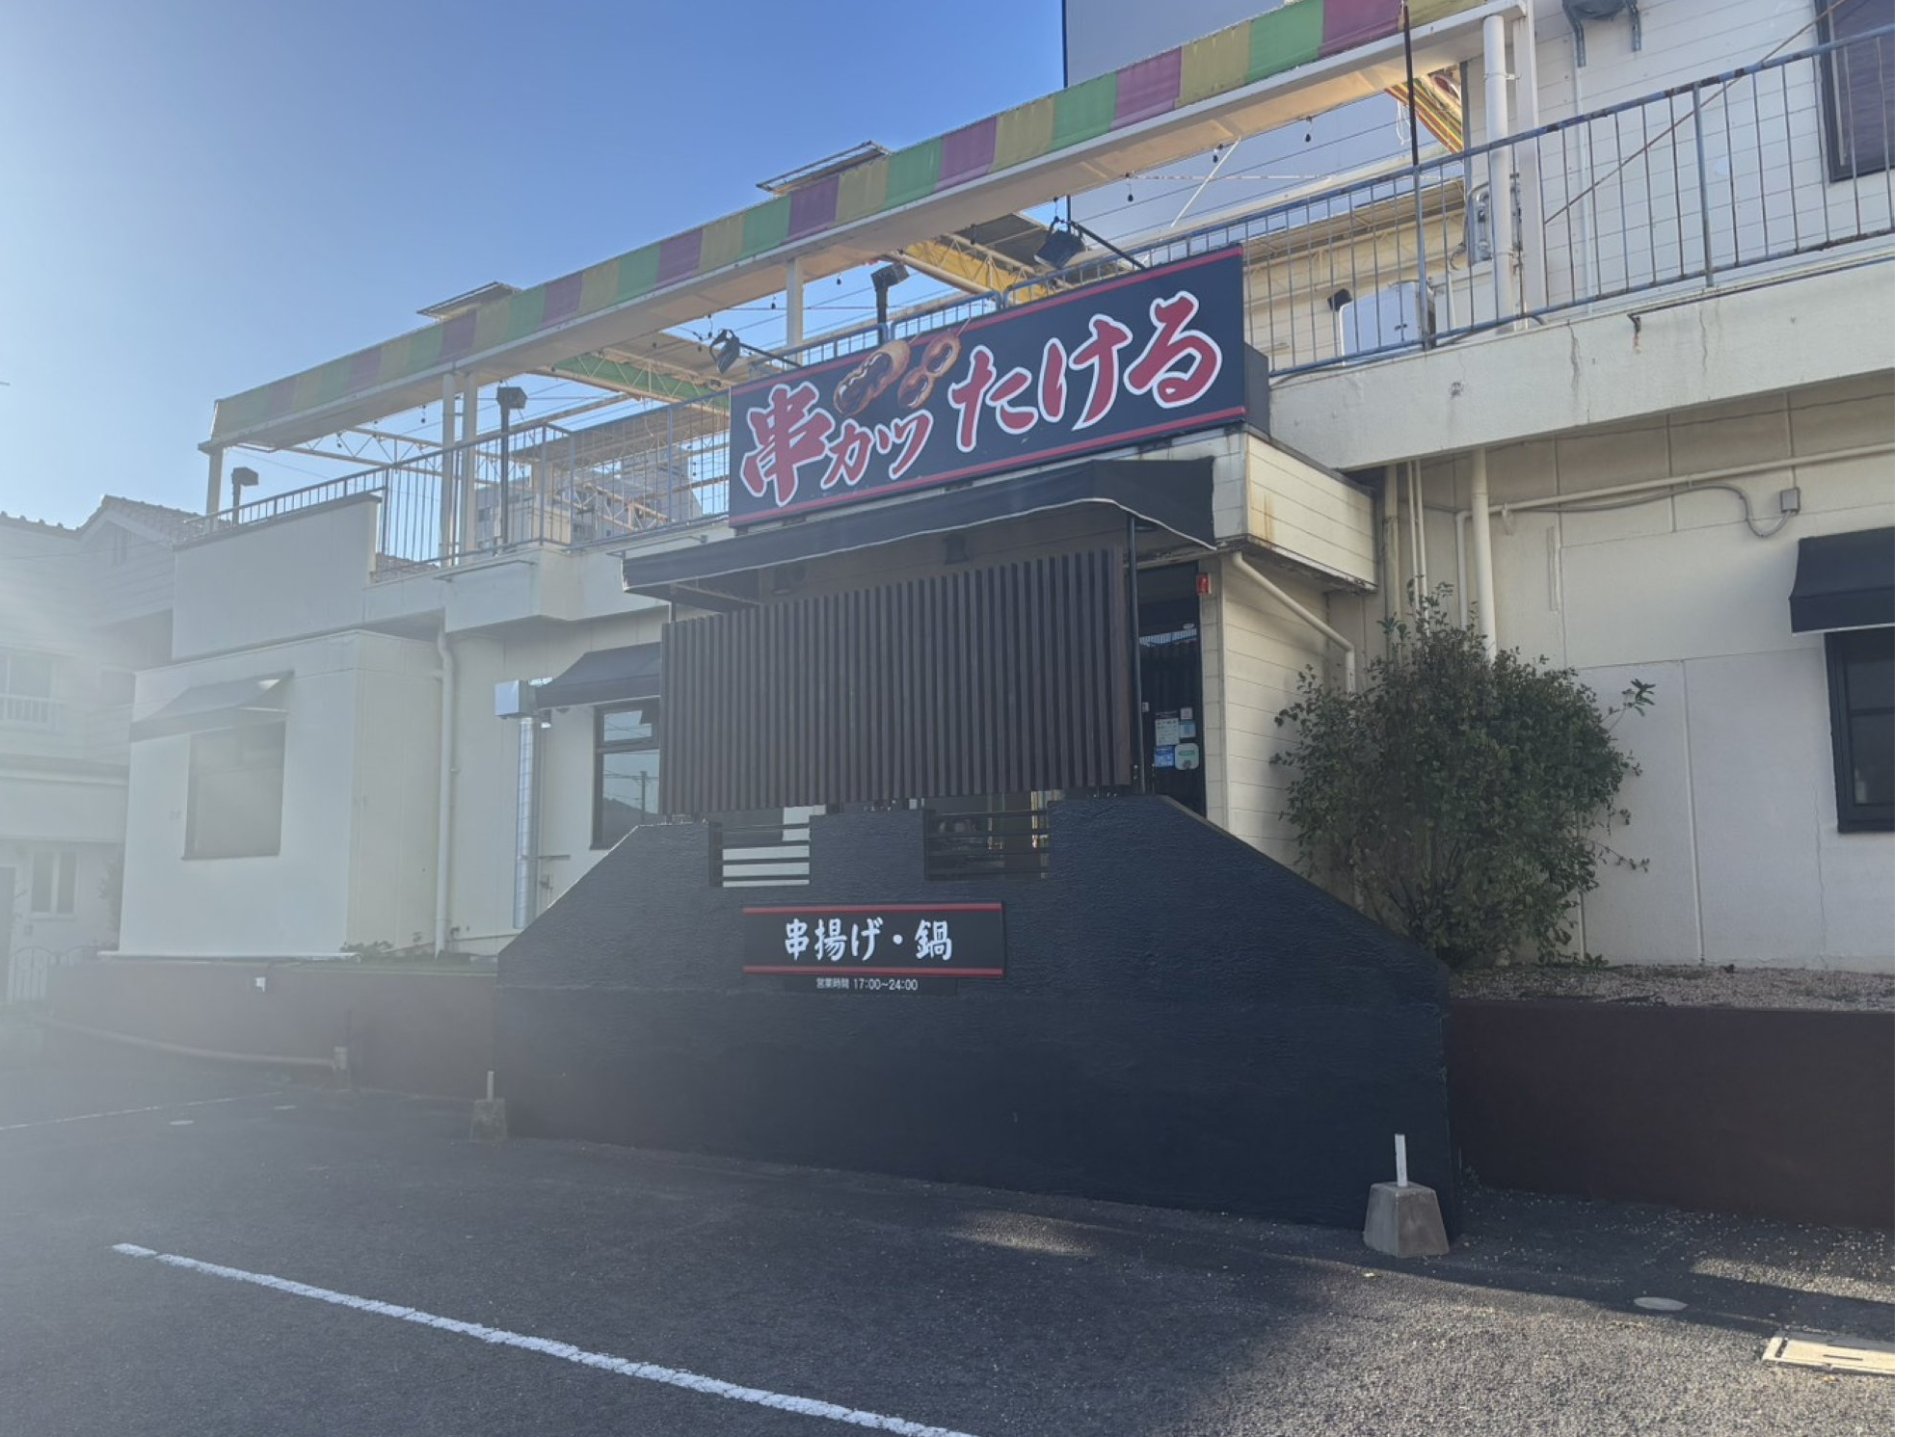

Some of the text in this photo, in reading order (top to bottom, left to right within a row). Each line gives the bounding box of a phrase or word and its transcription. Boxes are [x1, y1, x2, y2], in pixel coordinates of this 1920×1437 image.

[740, 291, 1222, 507] 串カツ たける
[784, 917, 953, 961] 串揚げ・鍋
